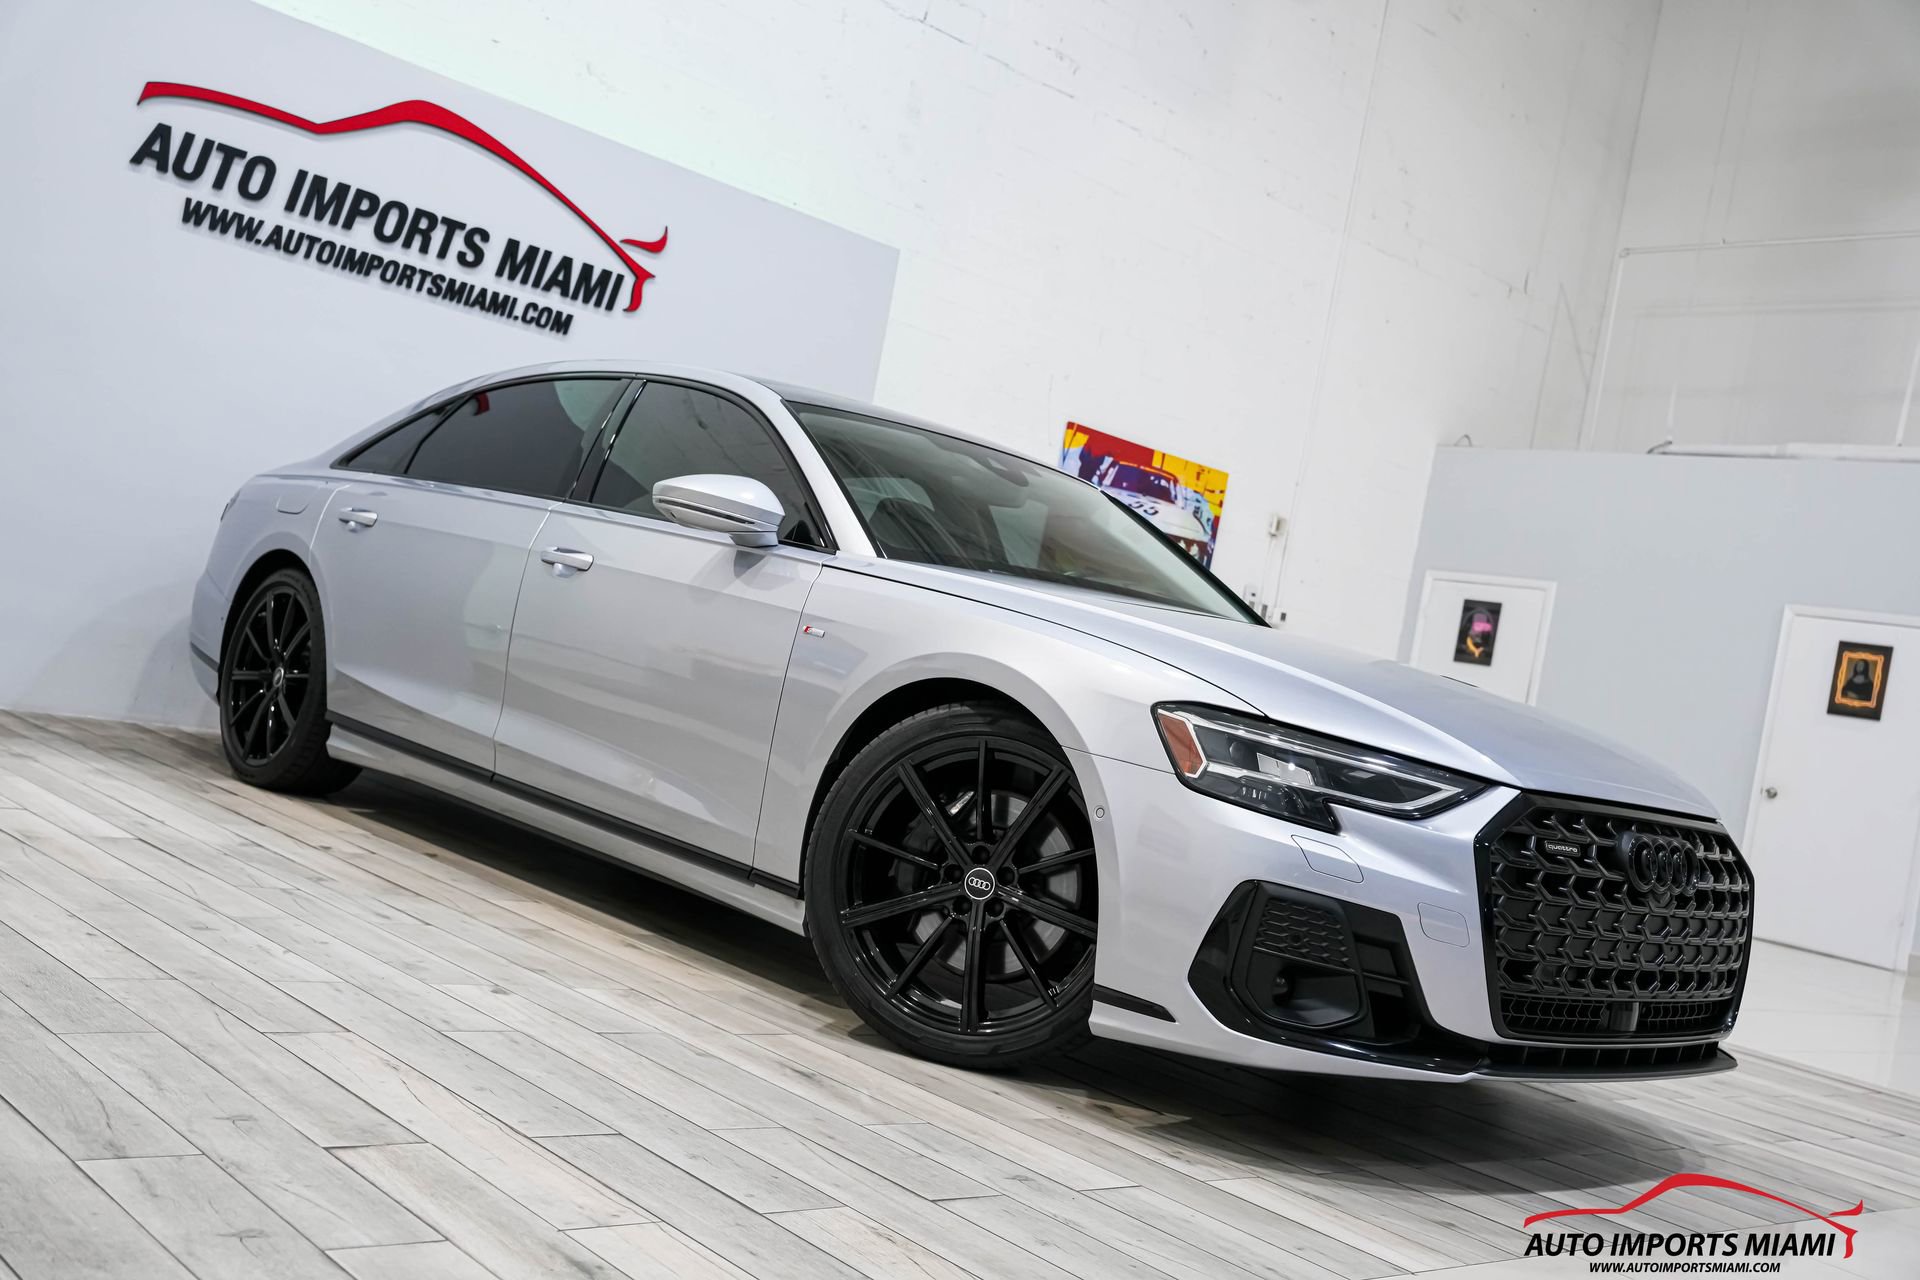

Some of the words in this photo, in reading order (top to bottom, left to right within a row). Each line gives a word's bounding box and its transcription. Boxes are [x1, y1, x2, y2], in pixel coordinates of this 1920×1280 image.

[129, 122, 277, 202] AUTO
[283, 169, 490, 269] IMPORTS
[495, 238, 625, 312] MIAMI
[181, 197, 574, 336] WWW.AUTOIMPORTSMIAMI.COM
[1547, 844, 1578, 853] quattro
